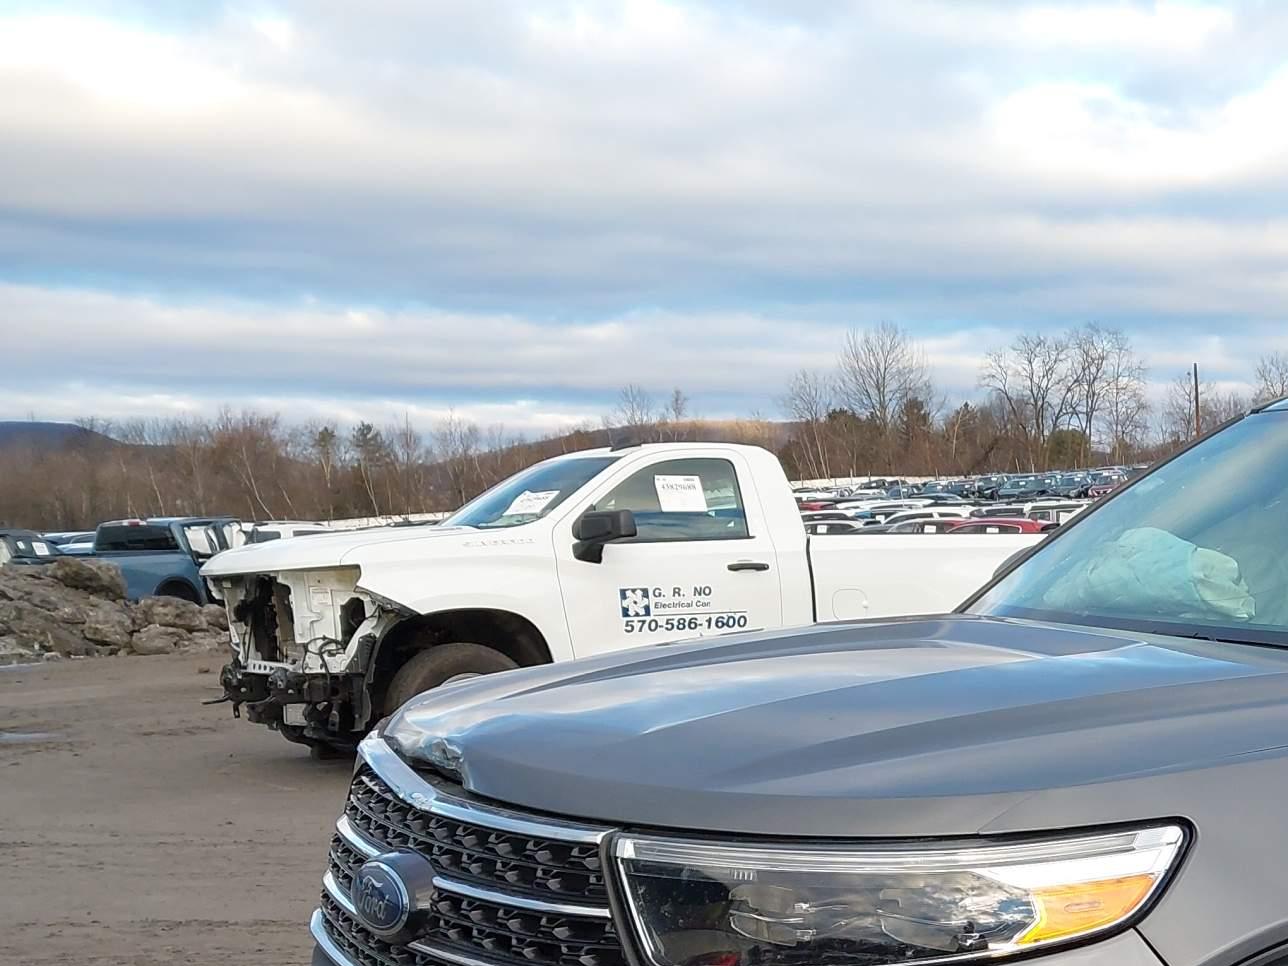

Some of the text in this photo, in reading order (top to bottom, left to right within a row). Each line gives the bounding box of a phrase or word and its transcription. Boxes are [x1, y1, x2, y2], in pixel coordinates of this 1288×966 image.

[652, 587, 666, 598] G.
[672, 586, 686, 598] R.
[654, 600, 694, 609] Electrical
[624, 615, 748, 634] 570-586-1600
